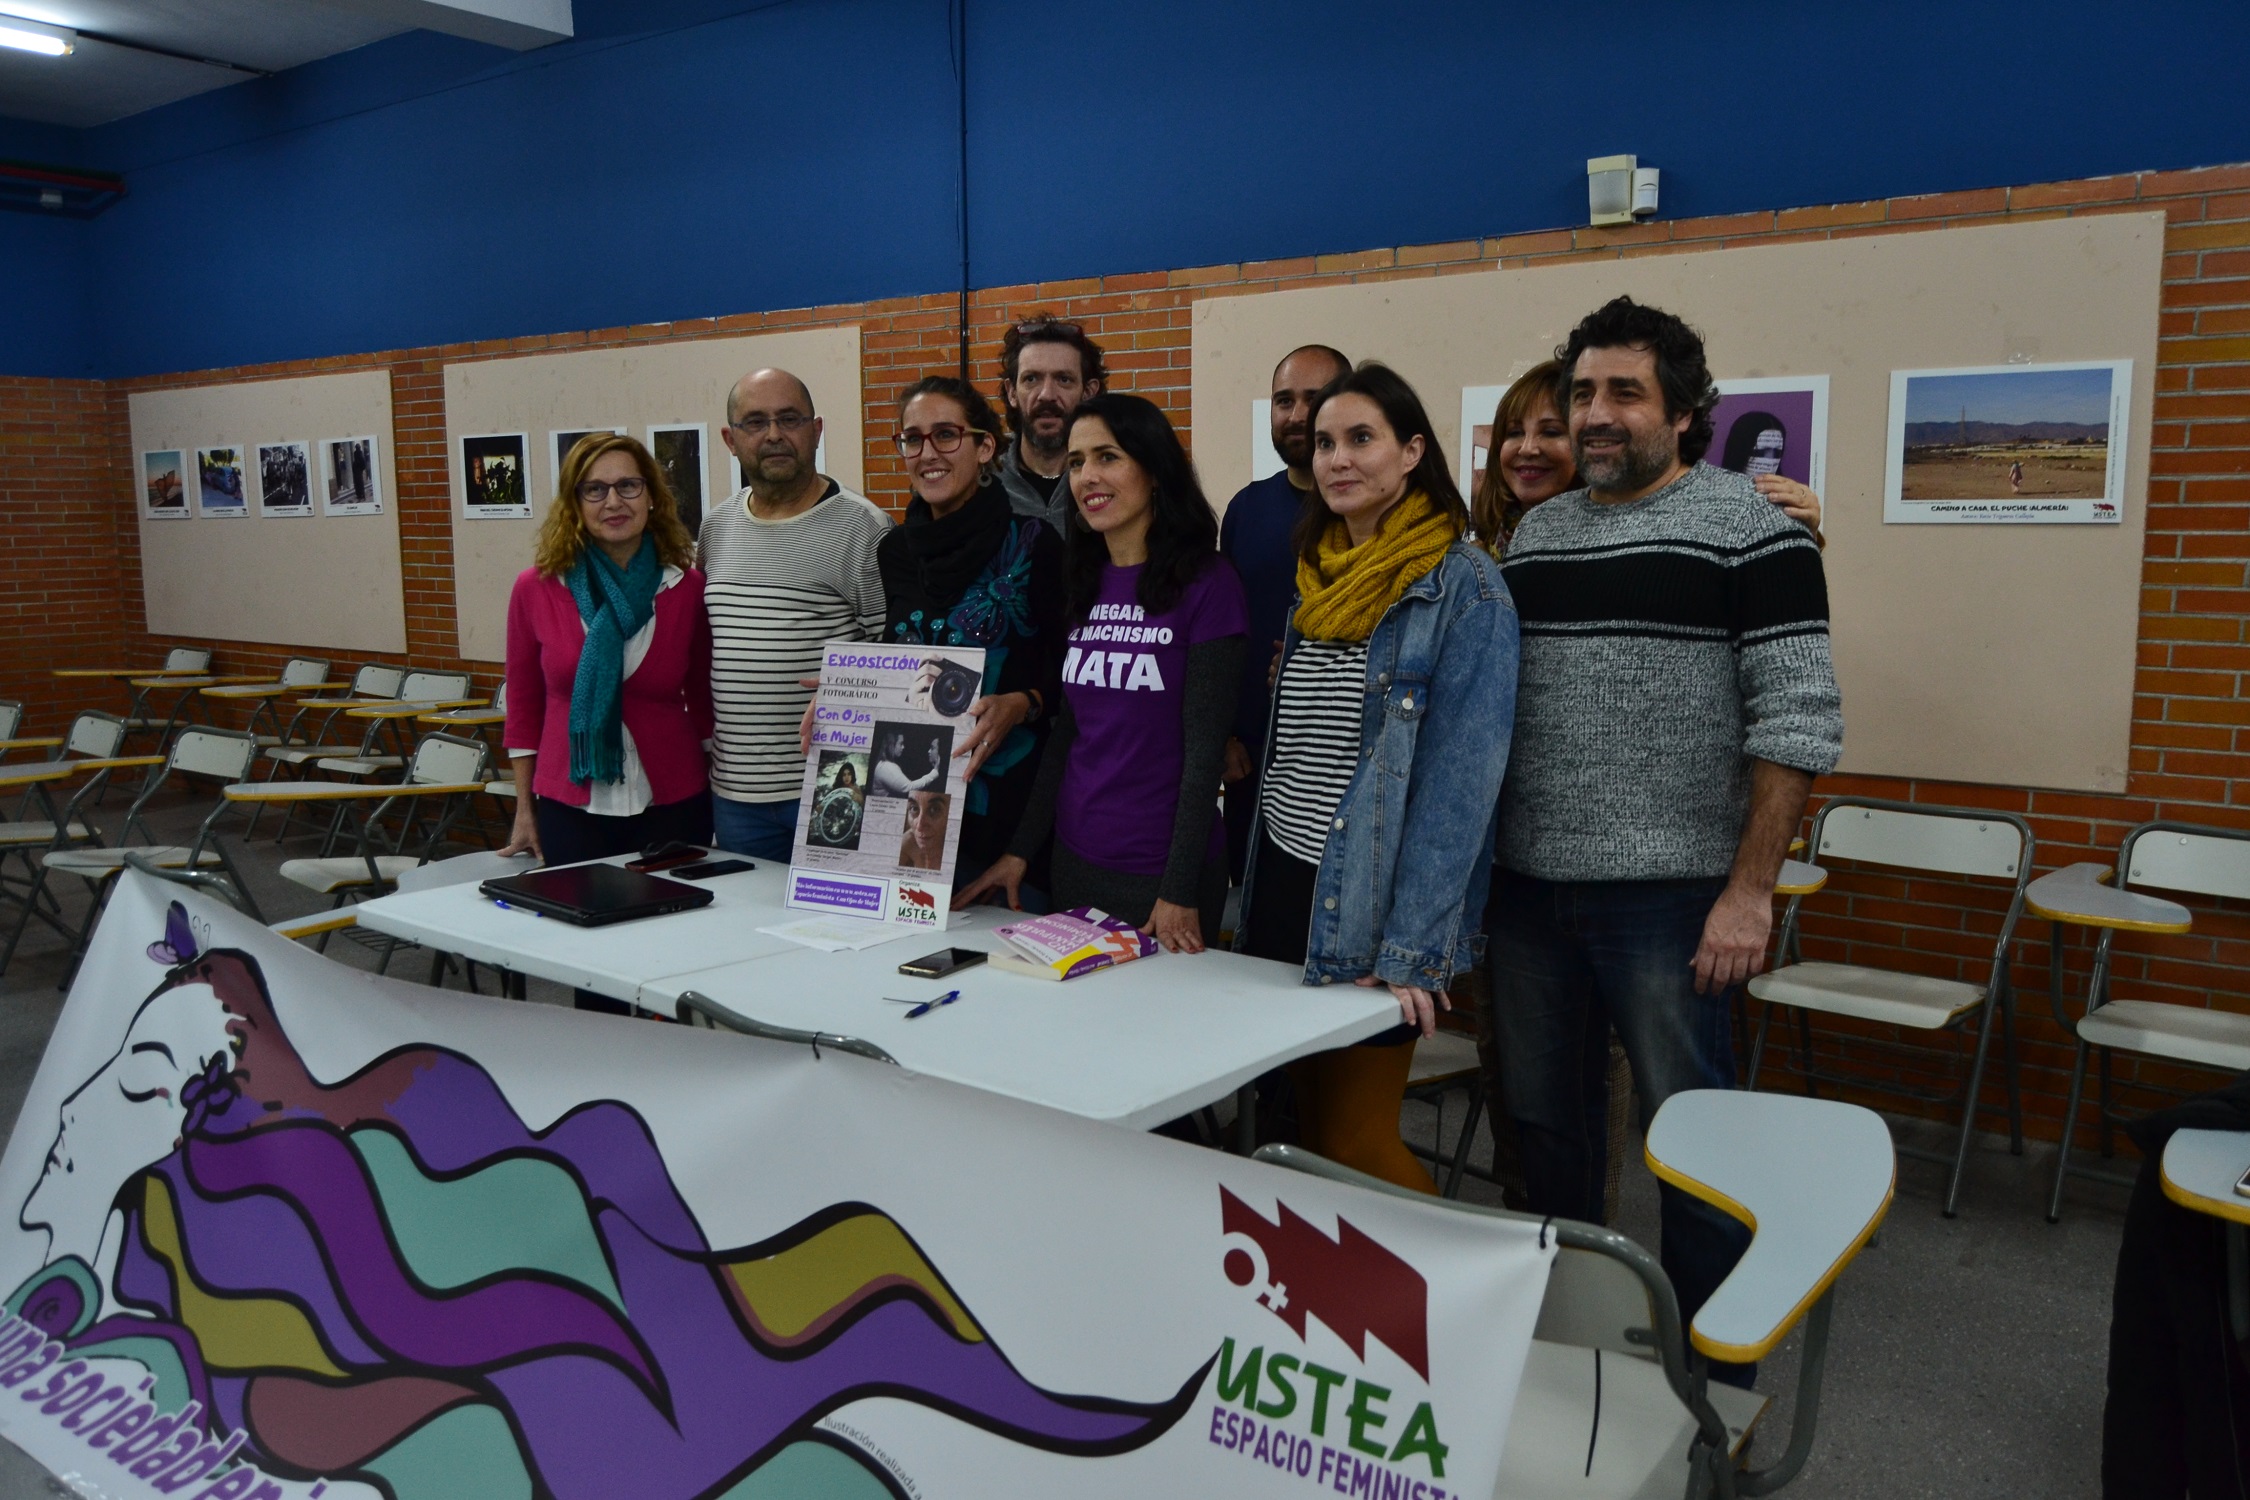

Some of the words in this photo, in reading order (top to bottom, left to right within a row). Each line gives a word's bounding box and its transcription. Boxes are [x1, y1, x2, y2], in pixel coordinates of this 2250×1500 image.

[1089, 603, 1145, 621] NEGAR
[1080, 625, 1173, 645] MACHISMO
[828, 653, 920, 671] EXPOSICIÓN
[1062, 647, 1165, 692] MATA
[827, 676, 831, 684] V
[835, 677, 878, 687] CONCURSO
[822, 688, 878, 699] FOTOGRÁFICO
[816, 707, 839, 720] Con
[842, 709, 871, 724] Ojos
[812, 731, 827, 742] de
[830, 730, 868, 746] Mujer
[898, 906, 937, 921] USTEA
[1217, 1336, 1449, 1478] USTEA
[21, 1360, 247, 1495] sociedad
[1209, 1406, 1313, 1478] ESPACIO
[1317, 1445, 1459, 1500] FEMINIS
[875, 1448, 916, 1492] realizada
